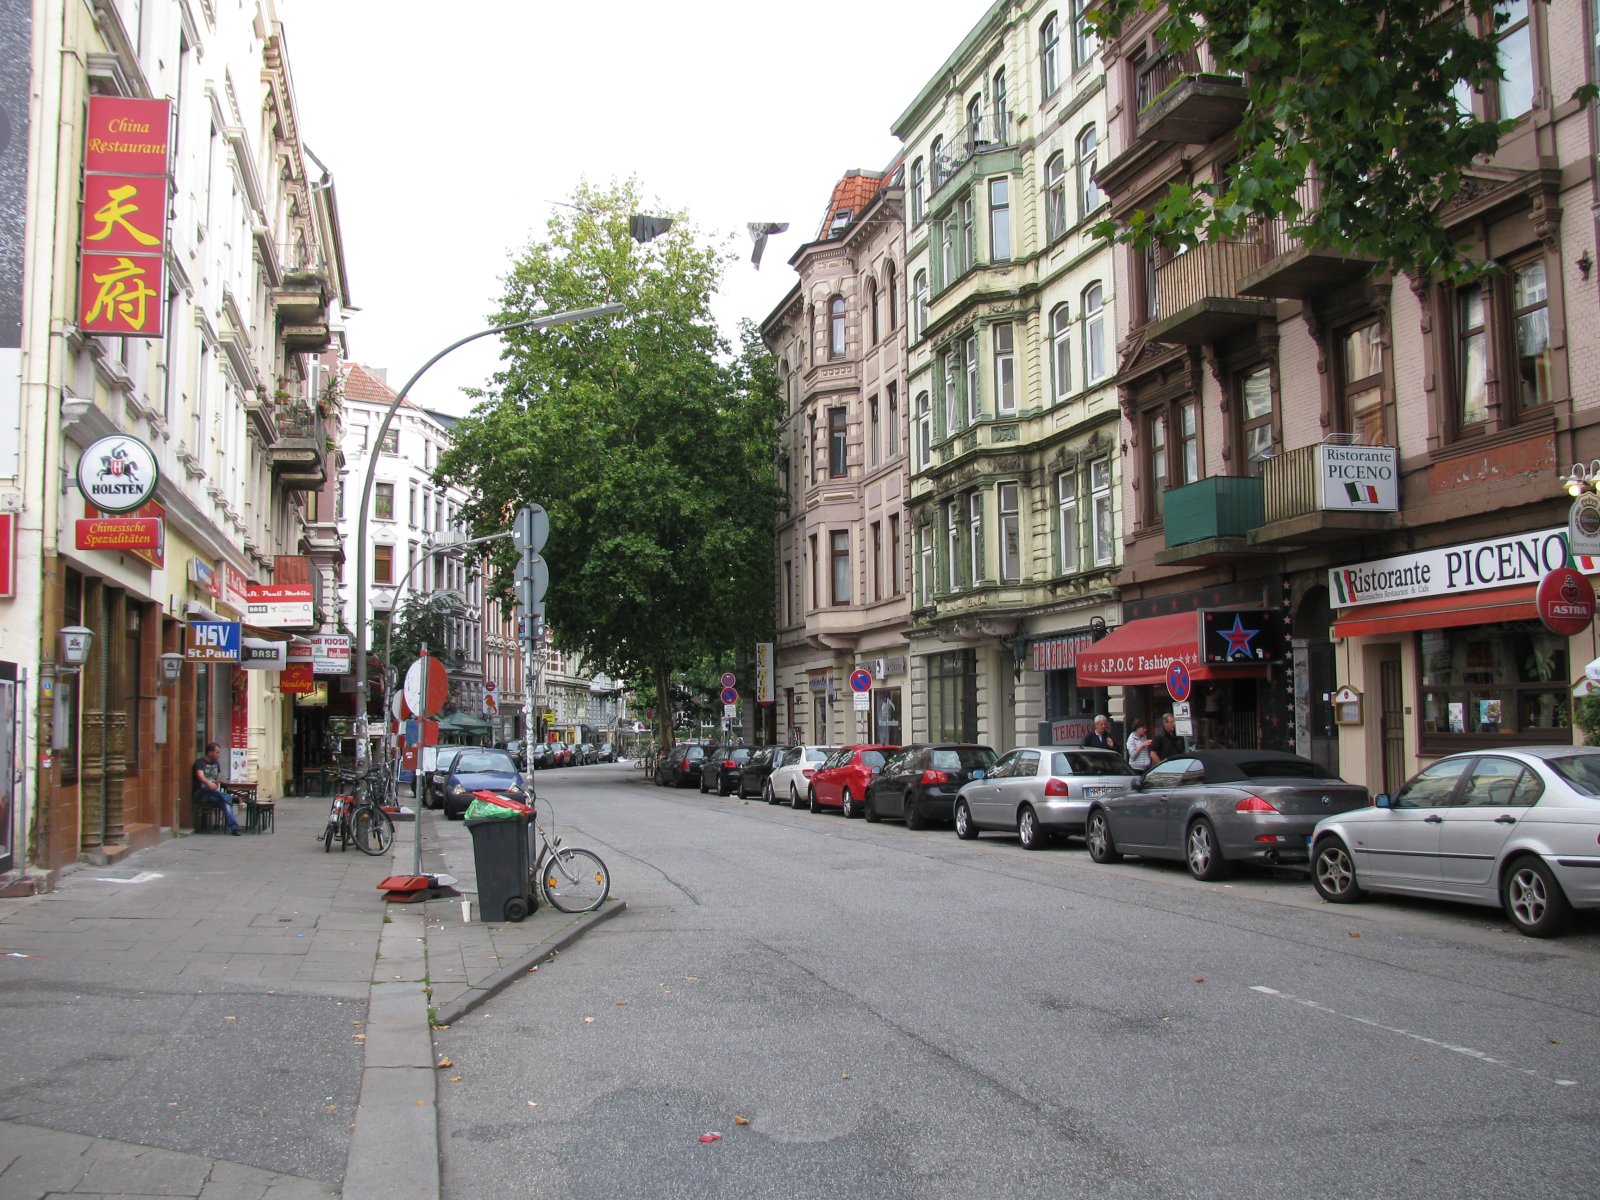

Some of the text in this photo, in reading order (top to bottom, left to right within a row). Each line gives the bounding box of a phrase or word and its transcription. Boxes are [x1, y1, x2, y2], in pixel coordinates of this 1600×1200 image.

[108, 117, 150, 133] China
[89, 138, 167, 154] Restaurant
[85, 184, 162, 331] 天府
[1327, 448, 1392, 462] Ristorante
[1328, 464, 1392, 480] PICENO
[92, 484, 144, 494] HOLSTEN
[89, 521, 147, 534] Chinesische
[84, 532, 151, 547] Spezialitäten
[1348, 534, 1568, 594] Ristorante PICENO
[1553, 605, 1587, 615] ASTRA
[195, 624, 230, 647] HSV
[187, 649, 238, 658] St.Pauli
[252, 649, 277, 658] BASE
[1101, 654, 1174, 673] S.P.O.C Fashion
[280, 680, 312, 690] Headshop
